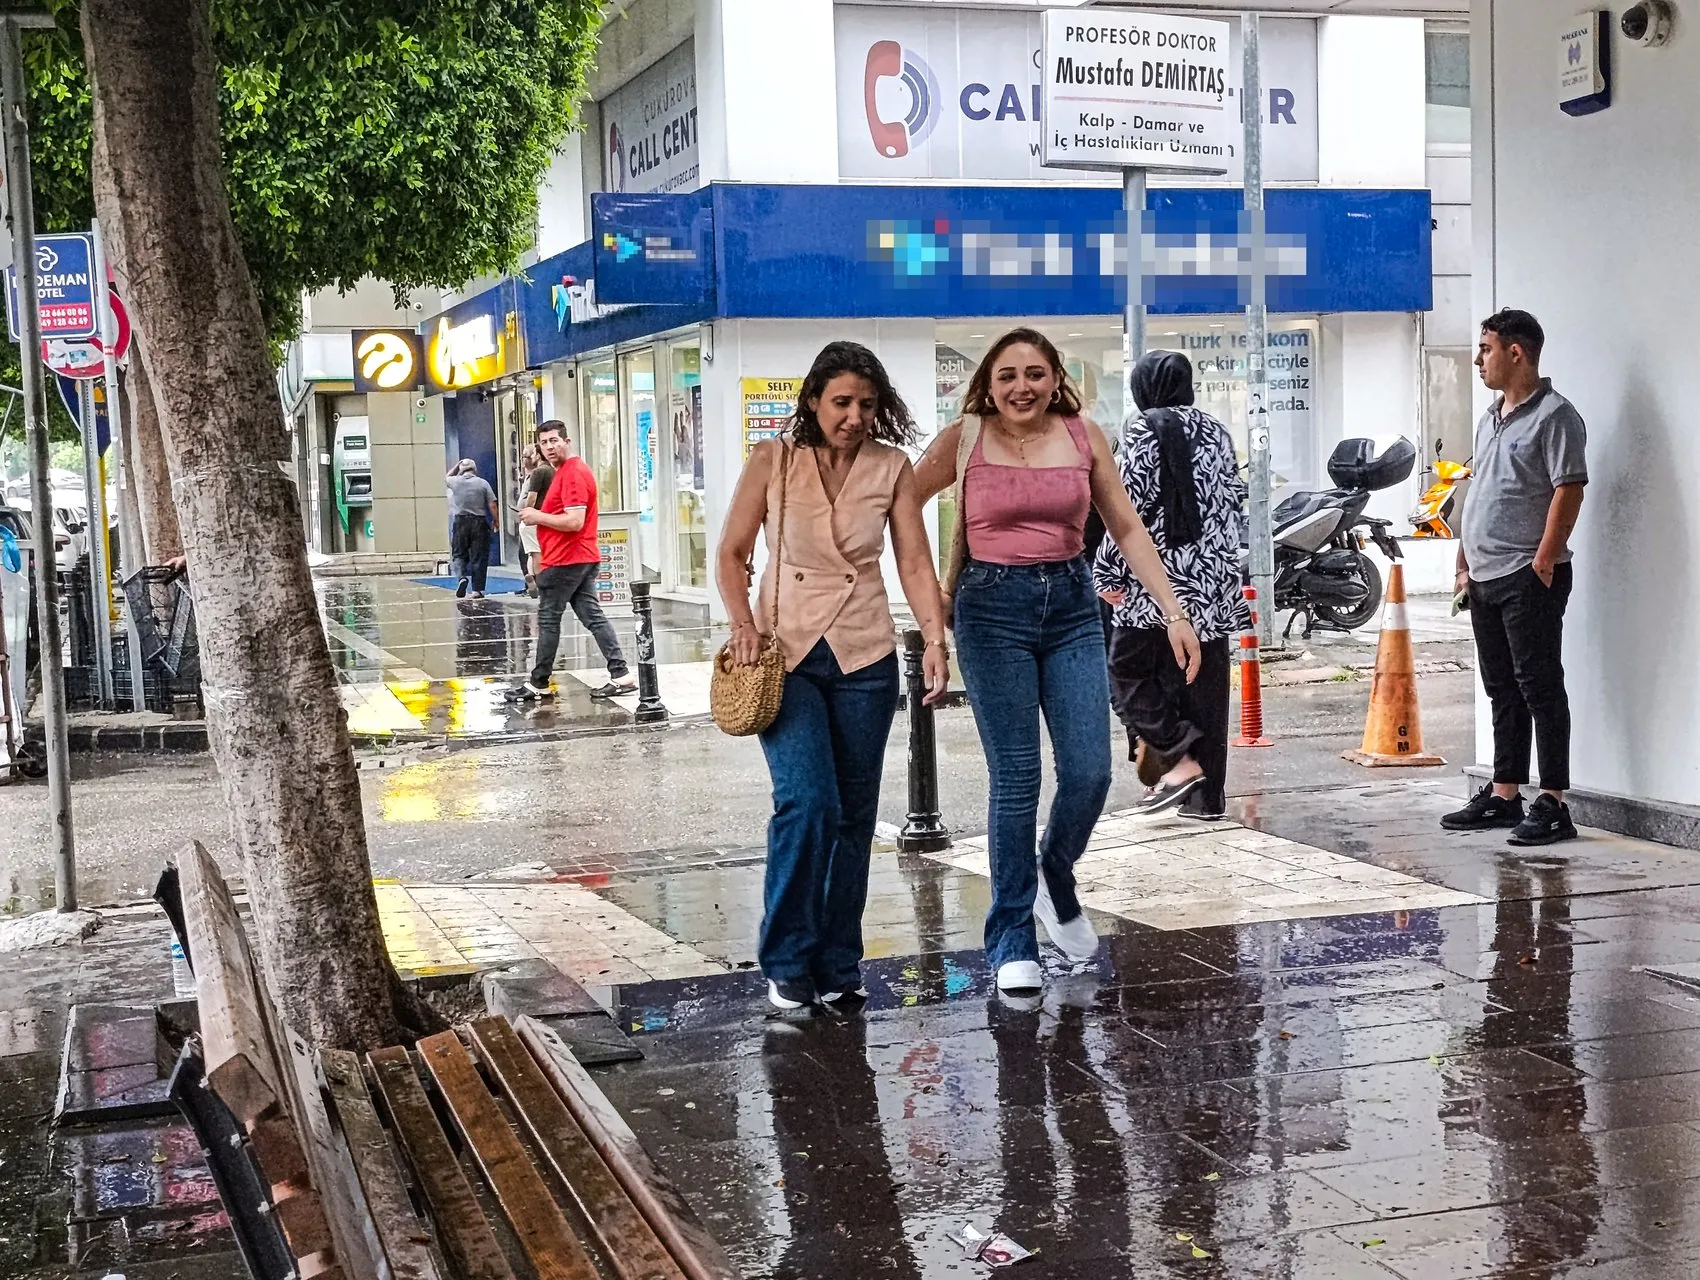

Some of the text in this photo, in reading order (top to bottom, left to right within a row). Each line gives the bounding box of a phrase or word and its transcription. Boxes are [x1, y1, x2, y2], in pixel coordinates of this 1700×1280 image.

[1066, 26, 1216, 52] PROFESÖR DOKTOR
[1055, 57, 1134, 87] Mustafa
[1141, 58, 1225, 102] DEMİRTAŞ
[1079, 113, 1115, 131] Kalp
[1133, 115, 1184, 132] Damar
[1188, 121, 1205, 133] ve
[1055, 130, 1068, 151] İç
[1074, 133, 1164, 152] Hastalıkları
[630, 133, 660, 178] CALL
[1180, 331, 1309, 349] Türk Tekom
[767, 382, 794, 391] SELFY
[748, 405, 759, 414] 20
[748, 419, 759, 428] 30
[748, 433, 759, 441] 40
[1397, 741, 1410, 752] M
